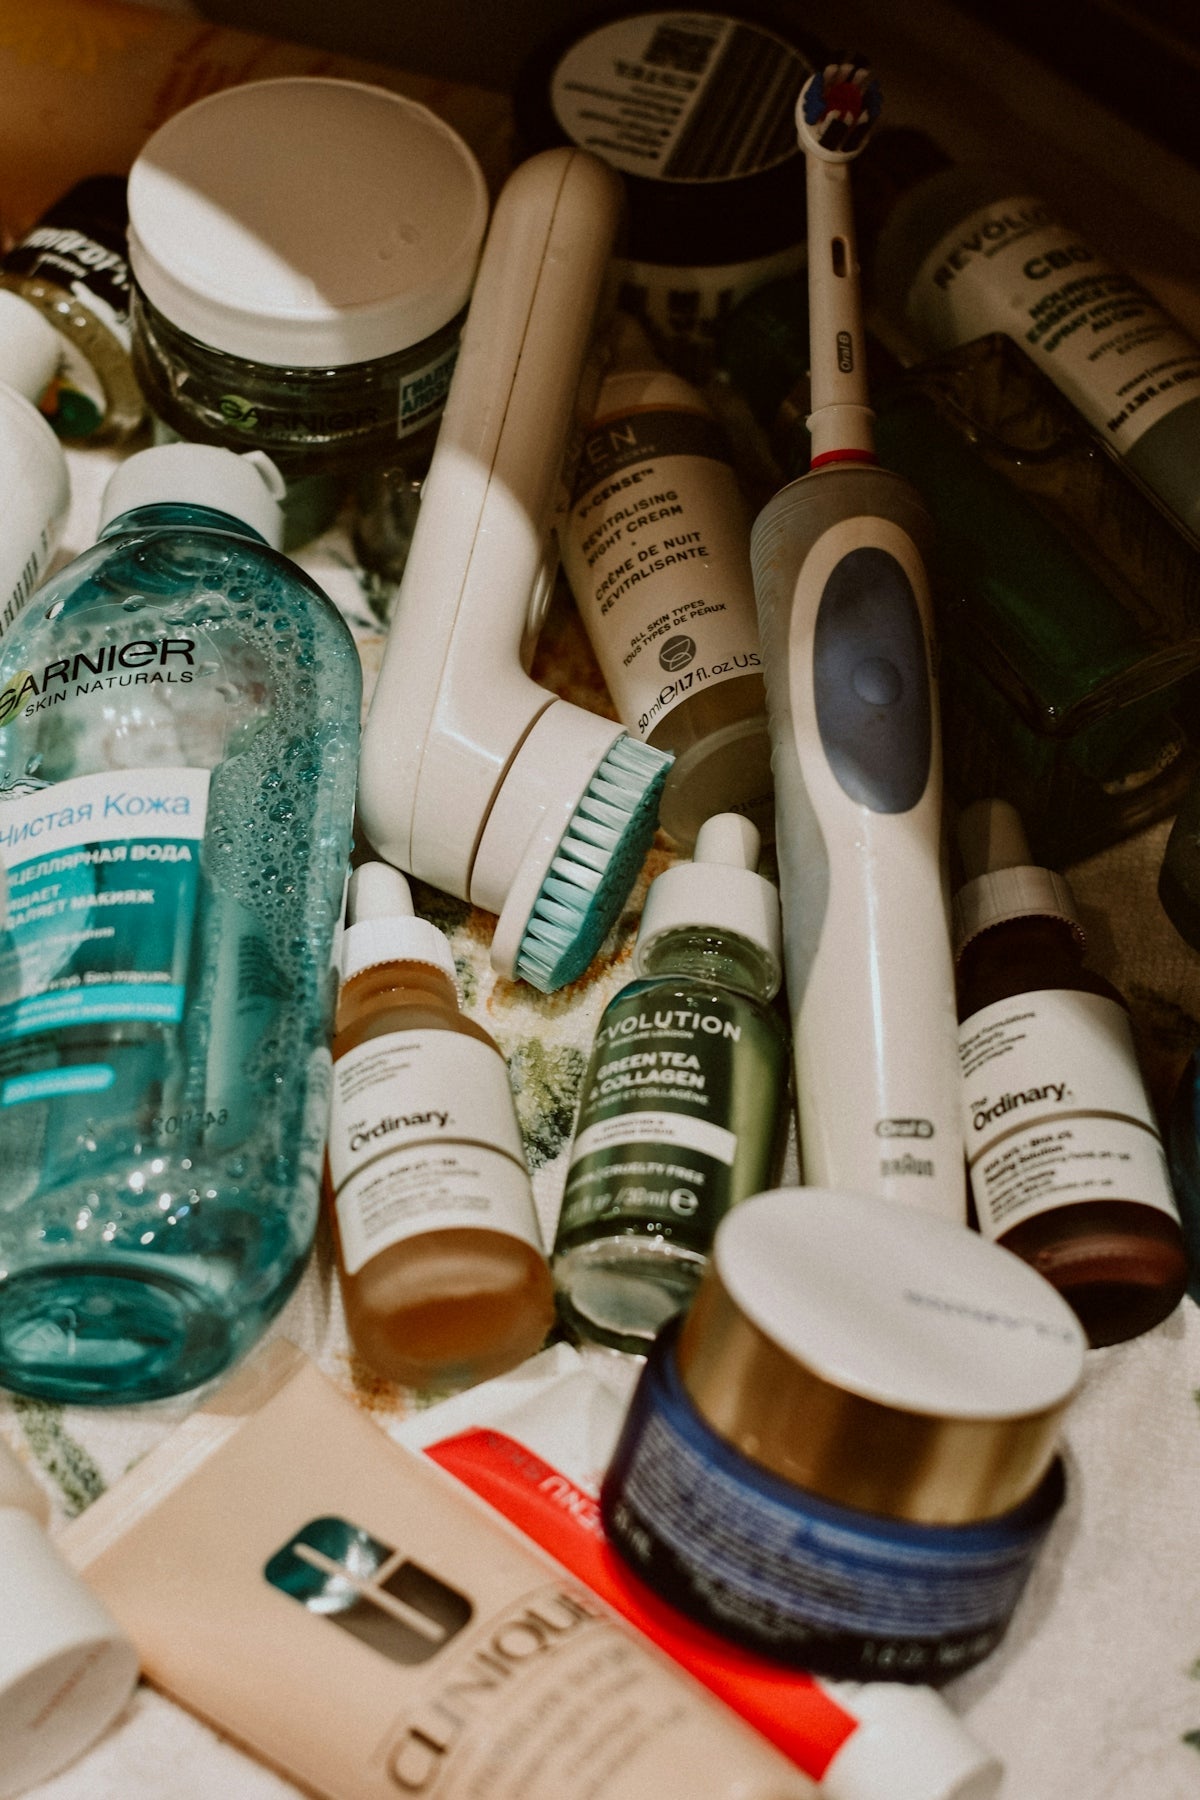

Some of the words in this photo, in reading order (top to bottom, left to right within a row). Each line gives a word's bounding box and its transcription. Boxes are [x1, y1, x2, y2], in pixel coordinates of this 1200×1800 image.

[581, 490, 678, 554] REVITALISING
[587, 529, 622, 568] NIGHT
[626, 504, 683, 533] CREAM
[638, 544, 659, 562] DE
[663, 531, 701, 550] NUIT
[600, 546, 709, 616] REVITALISANTE
[623, 646, 642, 667] TOUS
[643, 623, 671, 646] TYPES
[673, 615, 687, 627] DE
[690, 603, 727, 619] PEAUX
[630, 632, 646, 647] ALL
[647, 613, 670, 632] SKIN
[672, 599, 705, 616] TYPES
[25, 690, 67, 717] SKIN
[76, 671, 194, 696] NATURALS
[638, 713, 650, 735] 50
[103, 792, 191, 818] Кожа
[130, 844, 192, 863] ВОДА
[597, 1052, 658, 1081] GREEN
[659, 1051, 702, 1071] TEA
[600, 1069, 706, 1095] COLLAGEN
[666, 1164, 706, 1186] FREE
